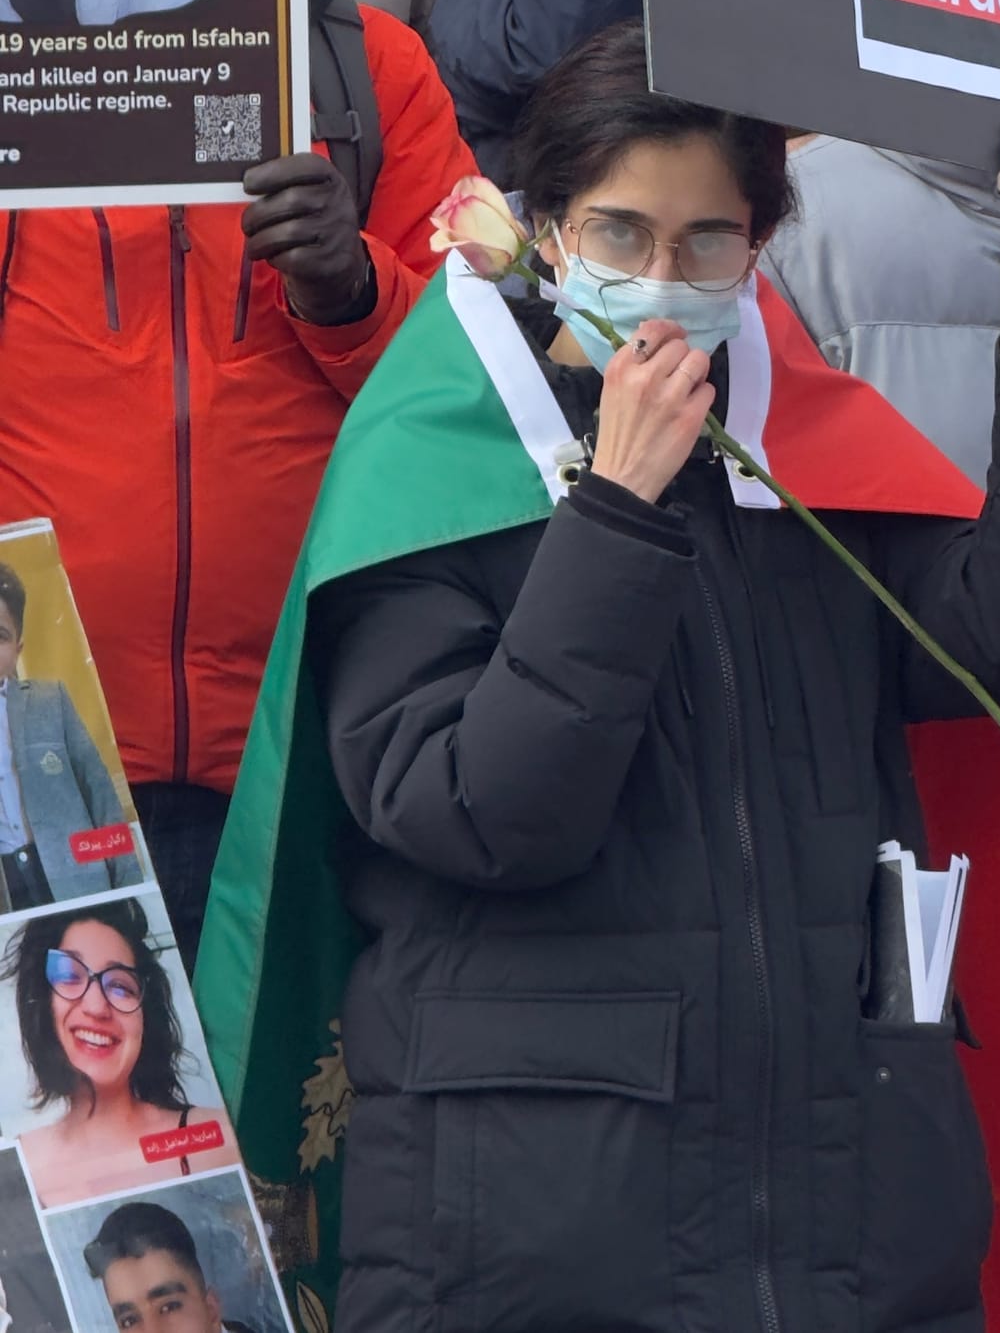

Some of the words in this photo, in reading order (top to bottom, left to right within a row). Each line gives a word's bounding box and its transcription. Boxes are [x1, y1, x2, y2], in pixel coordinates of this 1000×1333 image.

[29, 35, 88, 56] years
[93, 30, 128, 50] old
[134, 28, 185, 49] from
[193, 27, 270, 48] Isfahan
[0, 68, 35, 87] and
[40, 66, 97, 86] killed
[103, 71, 128, 84] on
[133, 65, 212, 85] January
[217, 62, 231, 81] 9
[3, 92, 91, 116] Republic
[97, 90, 172, 113] regime.
